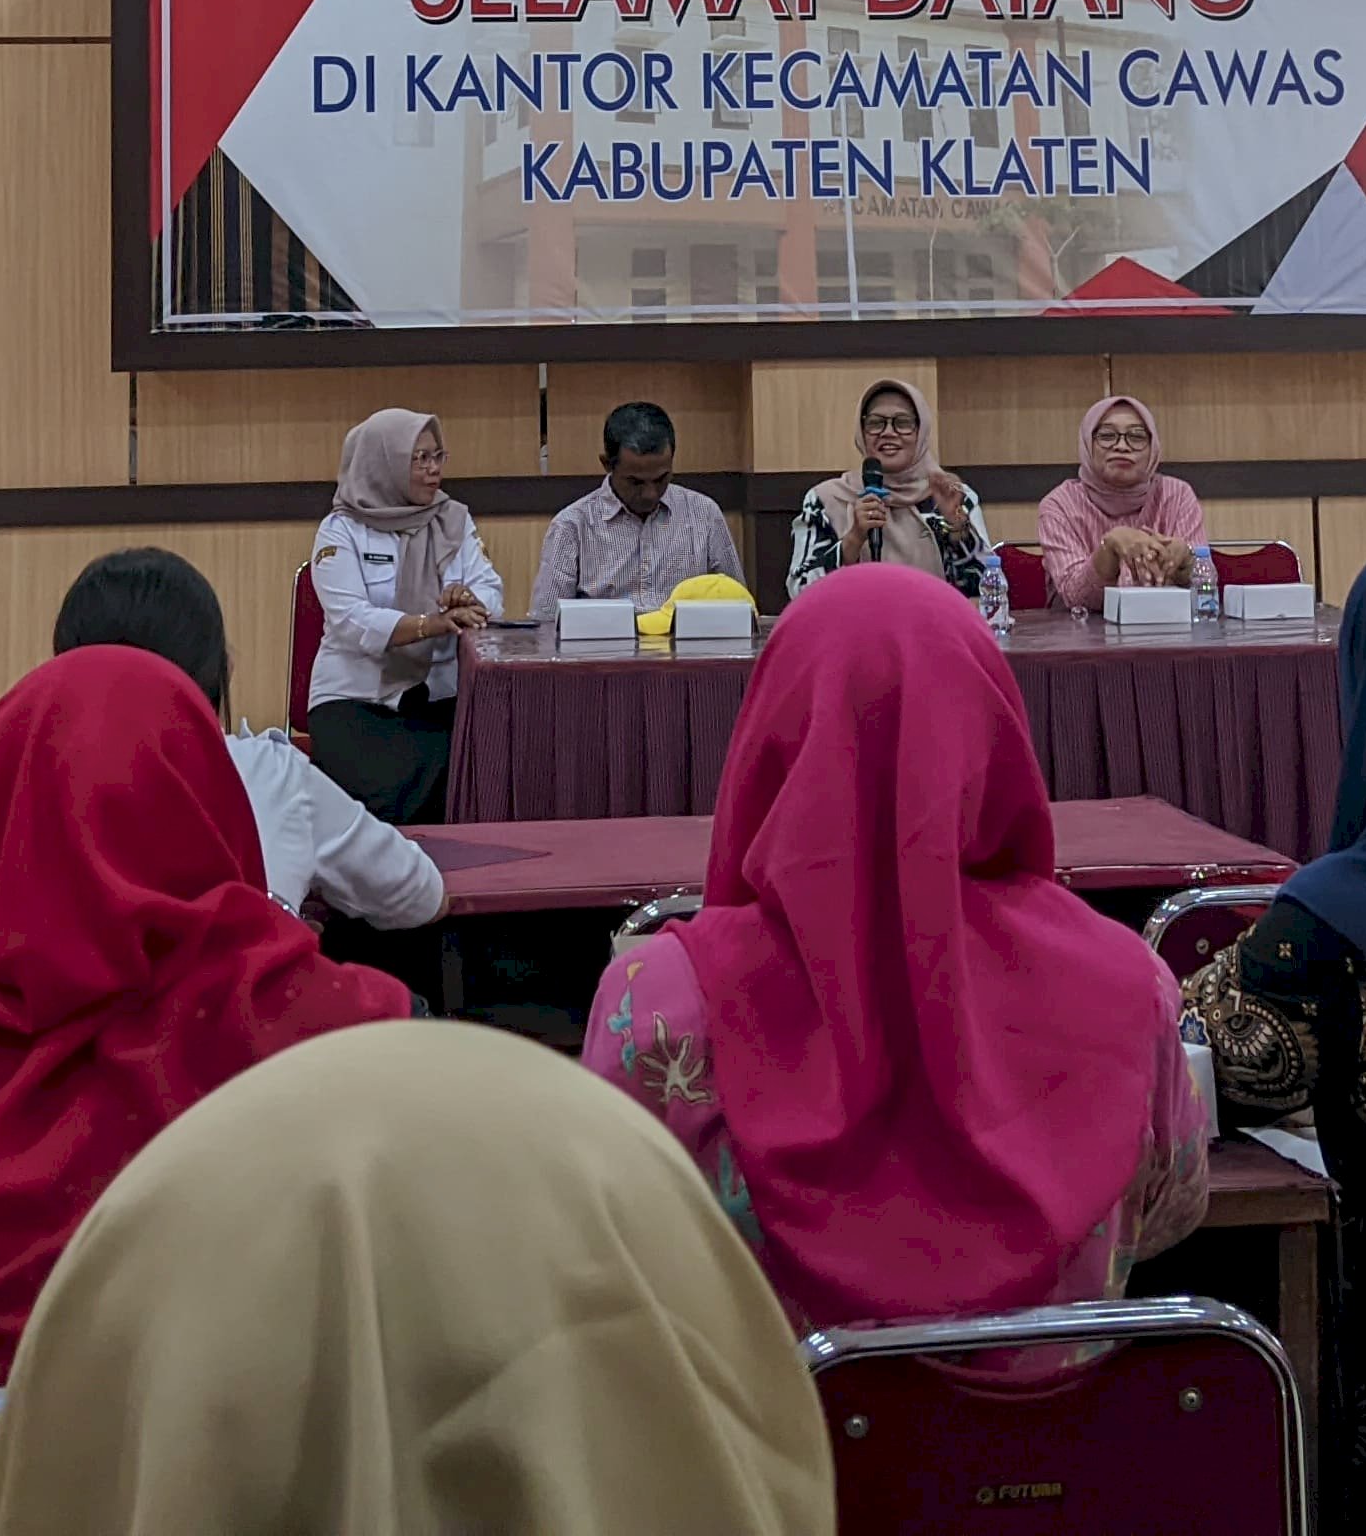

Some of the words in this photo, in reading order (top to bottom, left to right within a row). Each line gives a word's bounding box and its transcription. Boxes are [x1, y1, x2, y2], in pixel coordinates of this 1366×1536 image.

[312, 54, 376, 114] DI
[405, 50, 679, 113] KANTOR
[702, 49, 1092, 111] KECAMATAN
[1118, 48, 1346, 107] CAWAS
[522, 137, 895, 202] KABUPATEN
[921, 136, 1151, 198] KLATEN
